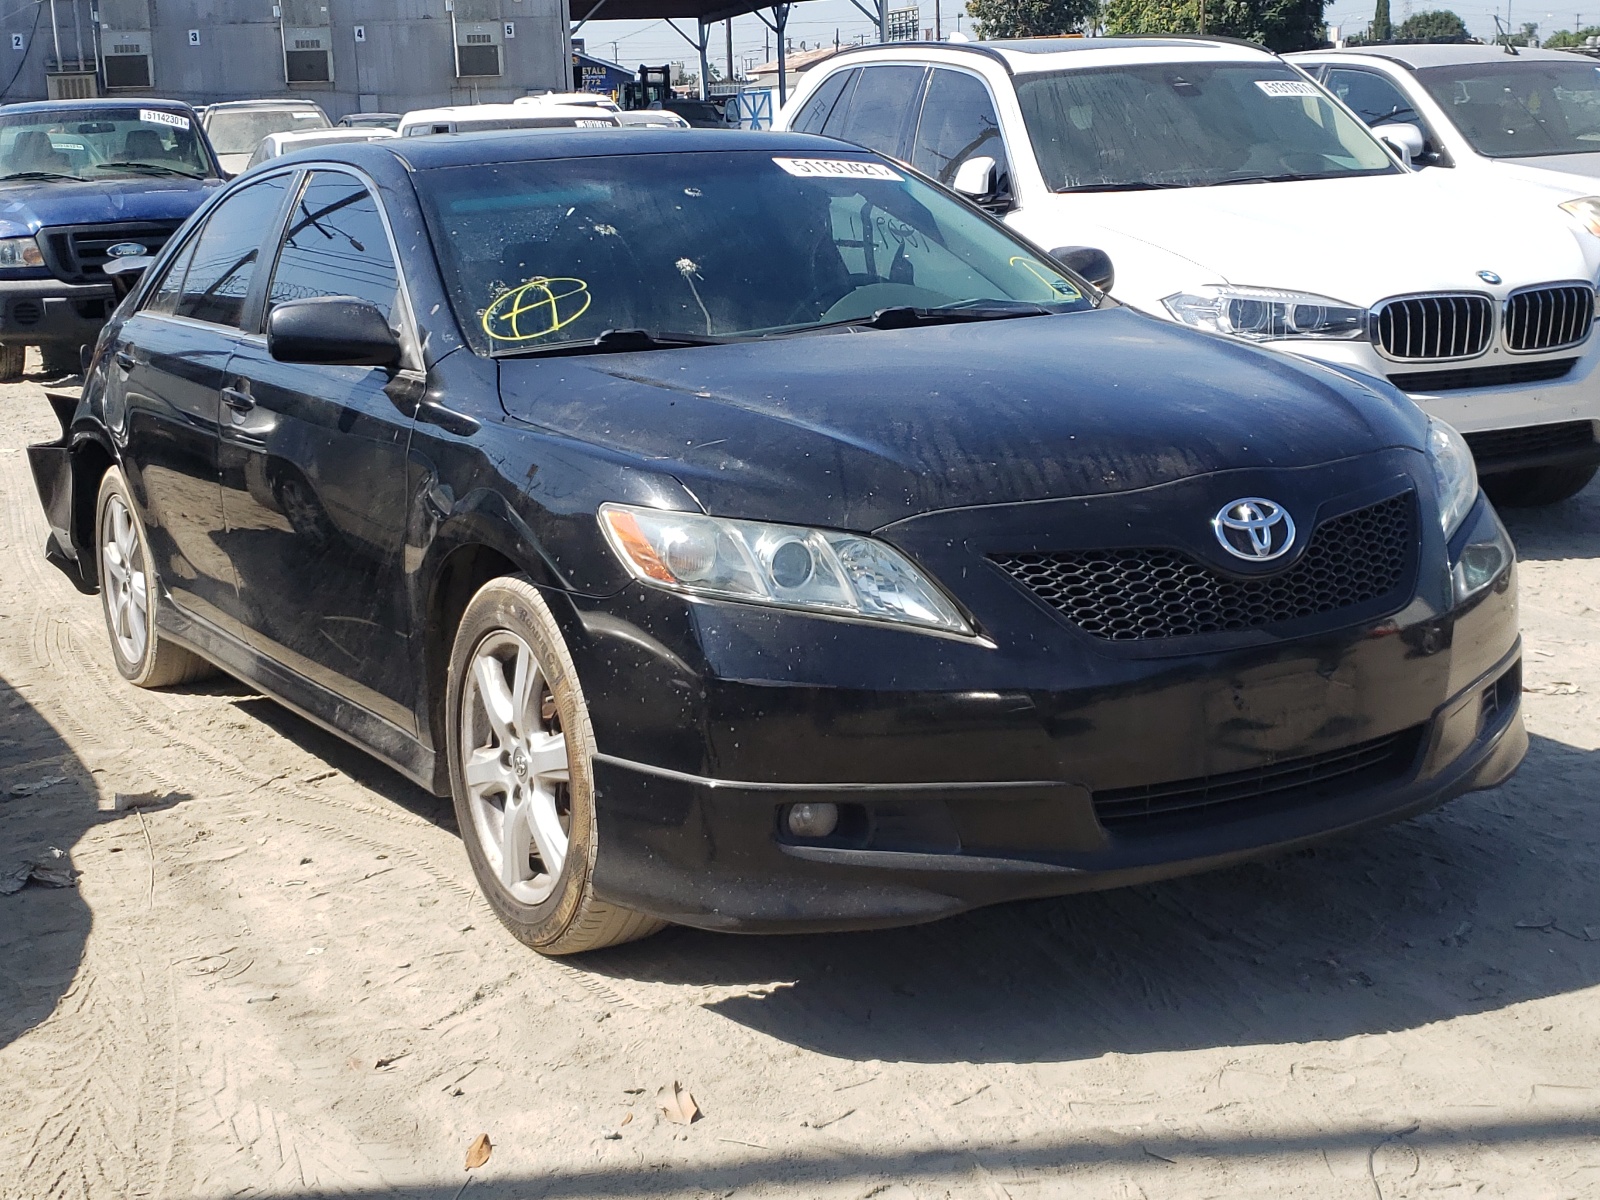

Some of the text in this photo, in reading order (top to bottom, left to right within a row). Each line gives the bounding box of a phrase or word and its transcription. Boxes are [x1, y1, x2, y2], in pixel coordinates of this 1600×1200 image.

[356, 28, 363, 39] 4
[506, 25, 513, 35] 5
[14, 36, 21, 46] 2
[191, 32, 198, 42] 3
[147, 111, 184, 126] 51142301
[791, 160, 885, 176] 51131421
